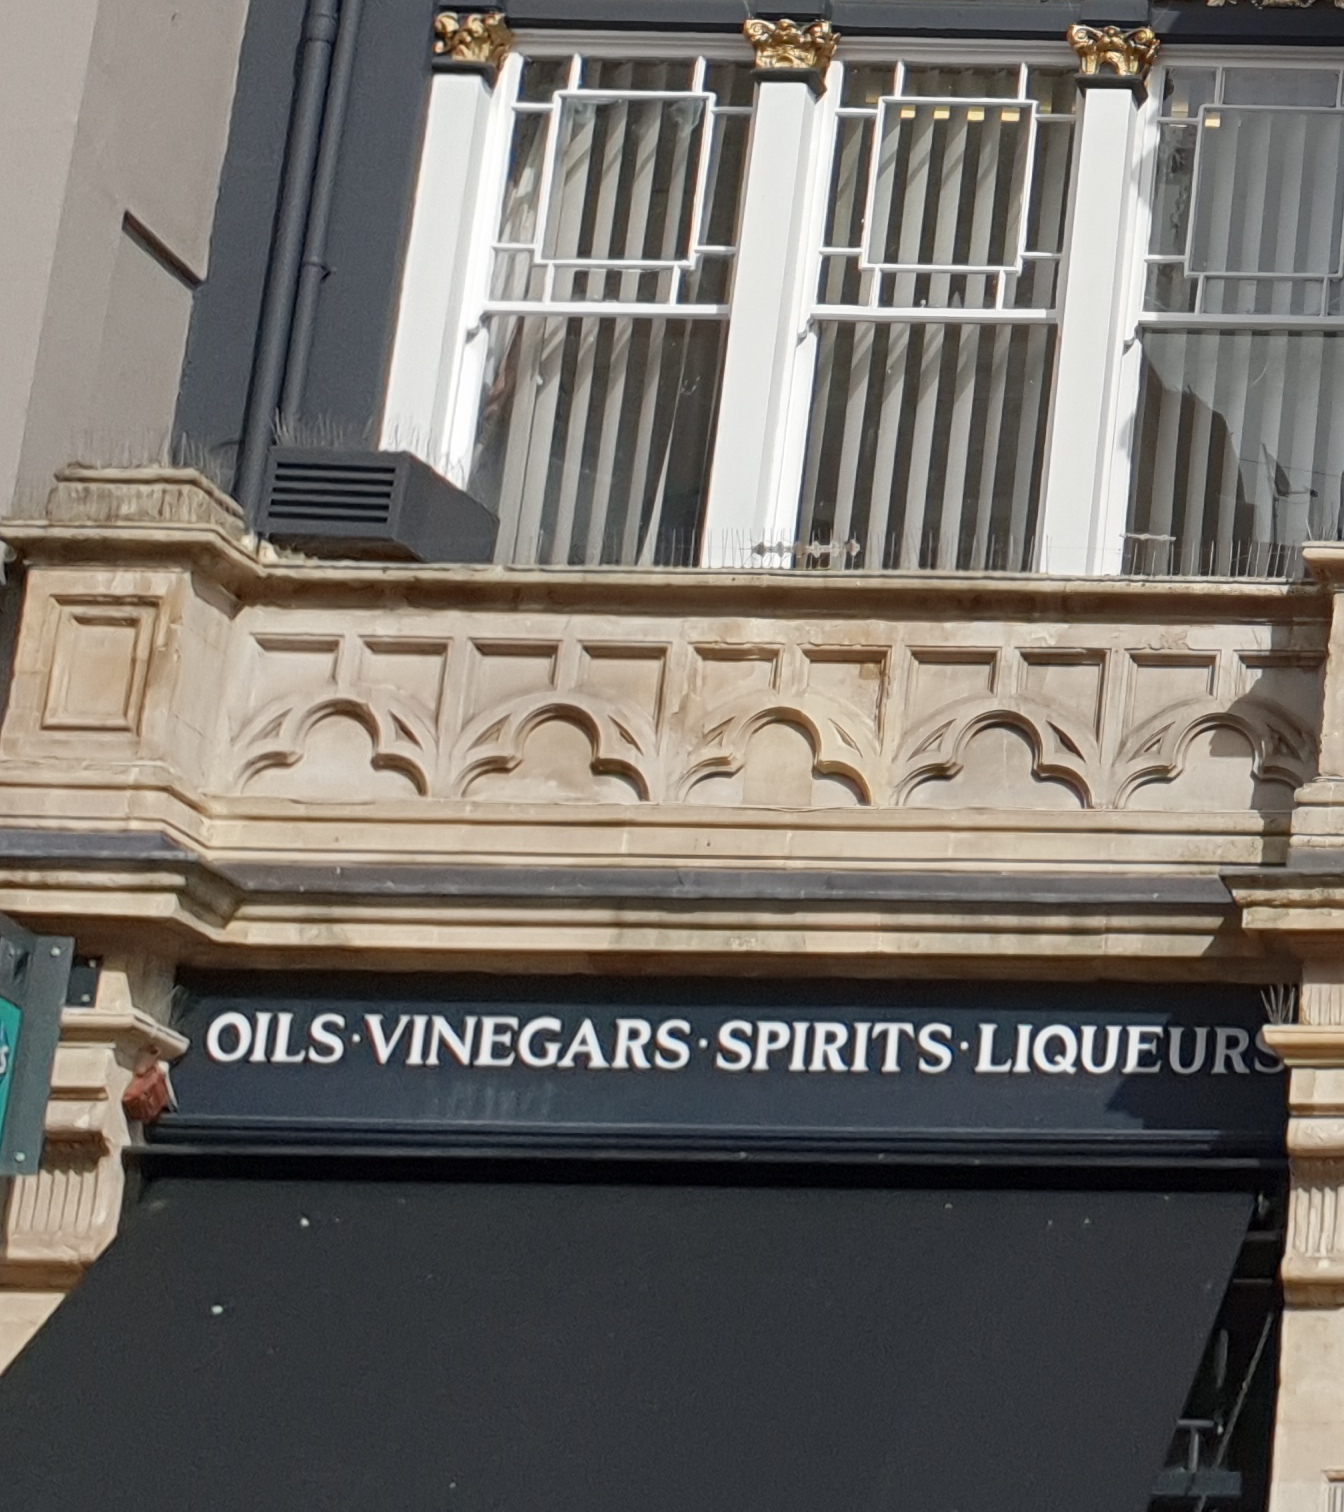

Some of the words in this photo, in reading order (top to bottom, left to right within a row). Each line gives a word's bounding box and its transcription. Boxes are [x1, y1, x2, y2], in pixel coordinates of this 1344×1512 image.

[207, 1011, 346, 1064] OILS
[365, 1013, 691, 1070] VINEGARS
[715, 1019, 953, 1074] SPIRITS
